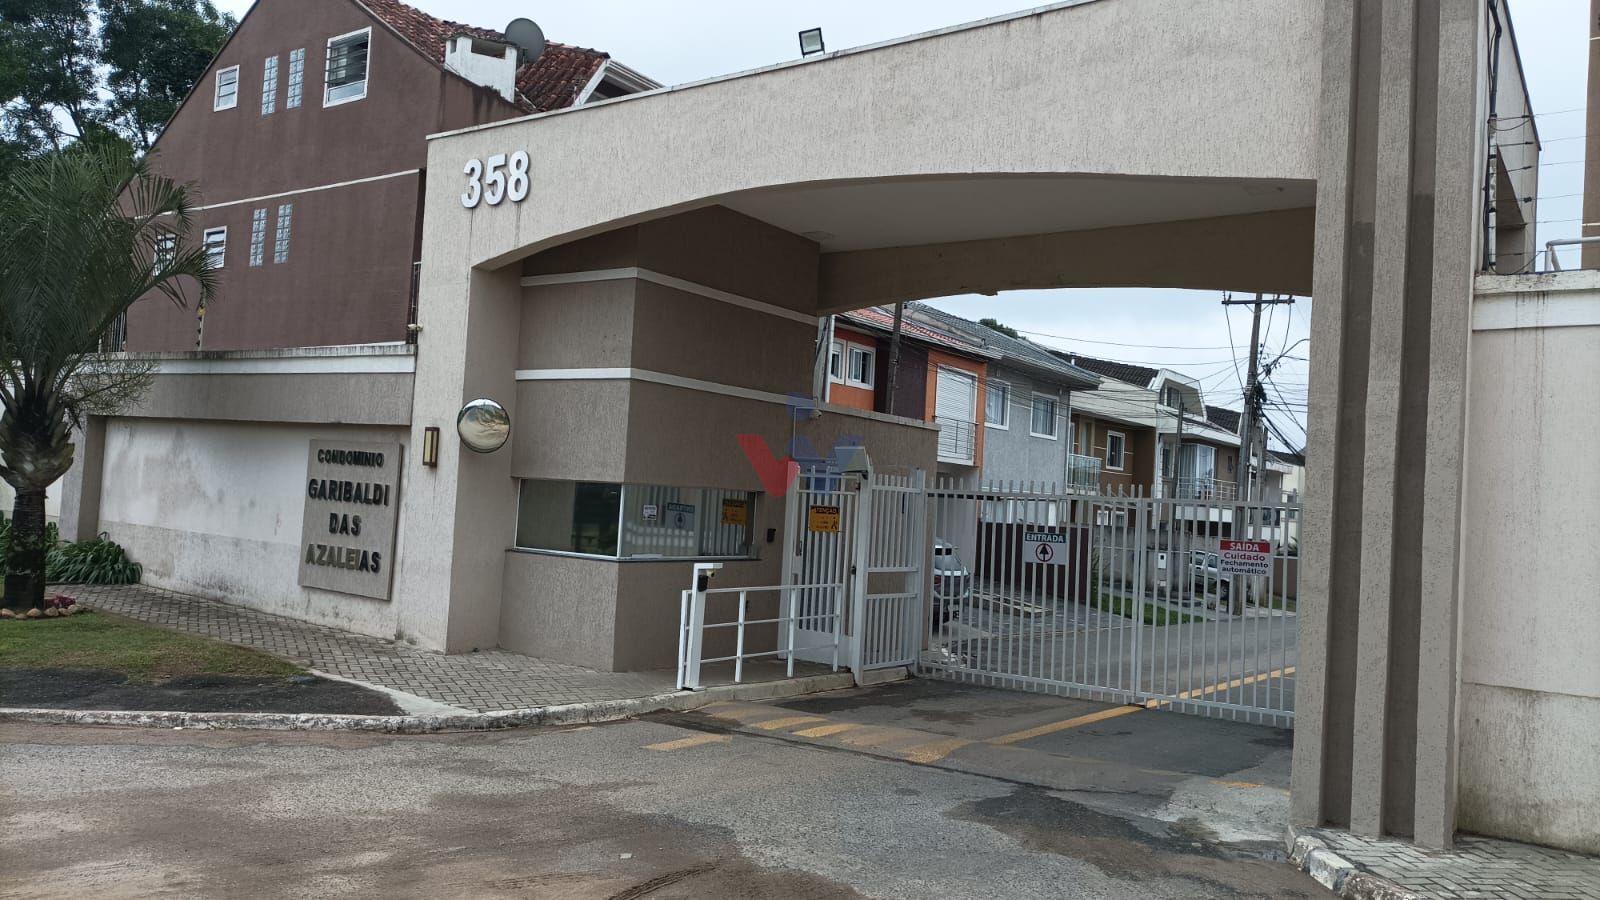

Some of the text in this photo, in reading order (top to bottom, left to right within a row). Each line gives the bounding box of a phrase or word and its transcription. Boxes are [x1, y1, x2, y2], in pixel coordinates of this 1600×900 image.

[461, 150, 530, 209] 358
[317, 449, 385, 468] CONDOMINIO
[308, 478, 391, 507] GARIBALDI
[328, 512, 362, 536] DAS
[1026, 533, 1064, 543] ENTRADA
[305, 543, 382, 573] AZALEIAS
[1220, 559, 1269, 569] Fechamento
[1223, 552, 1266, 562] Cuidado
[1221, 566, 1267, 575] automático
